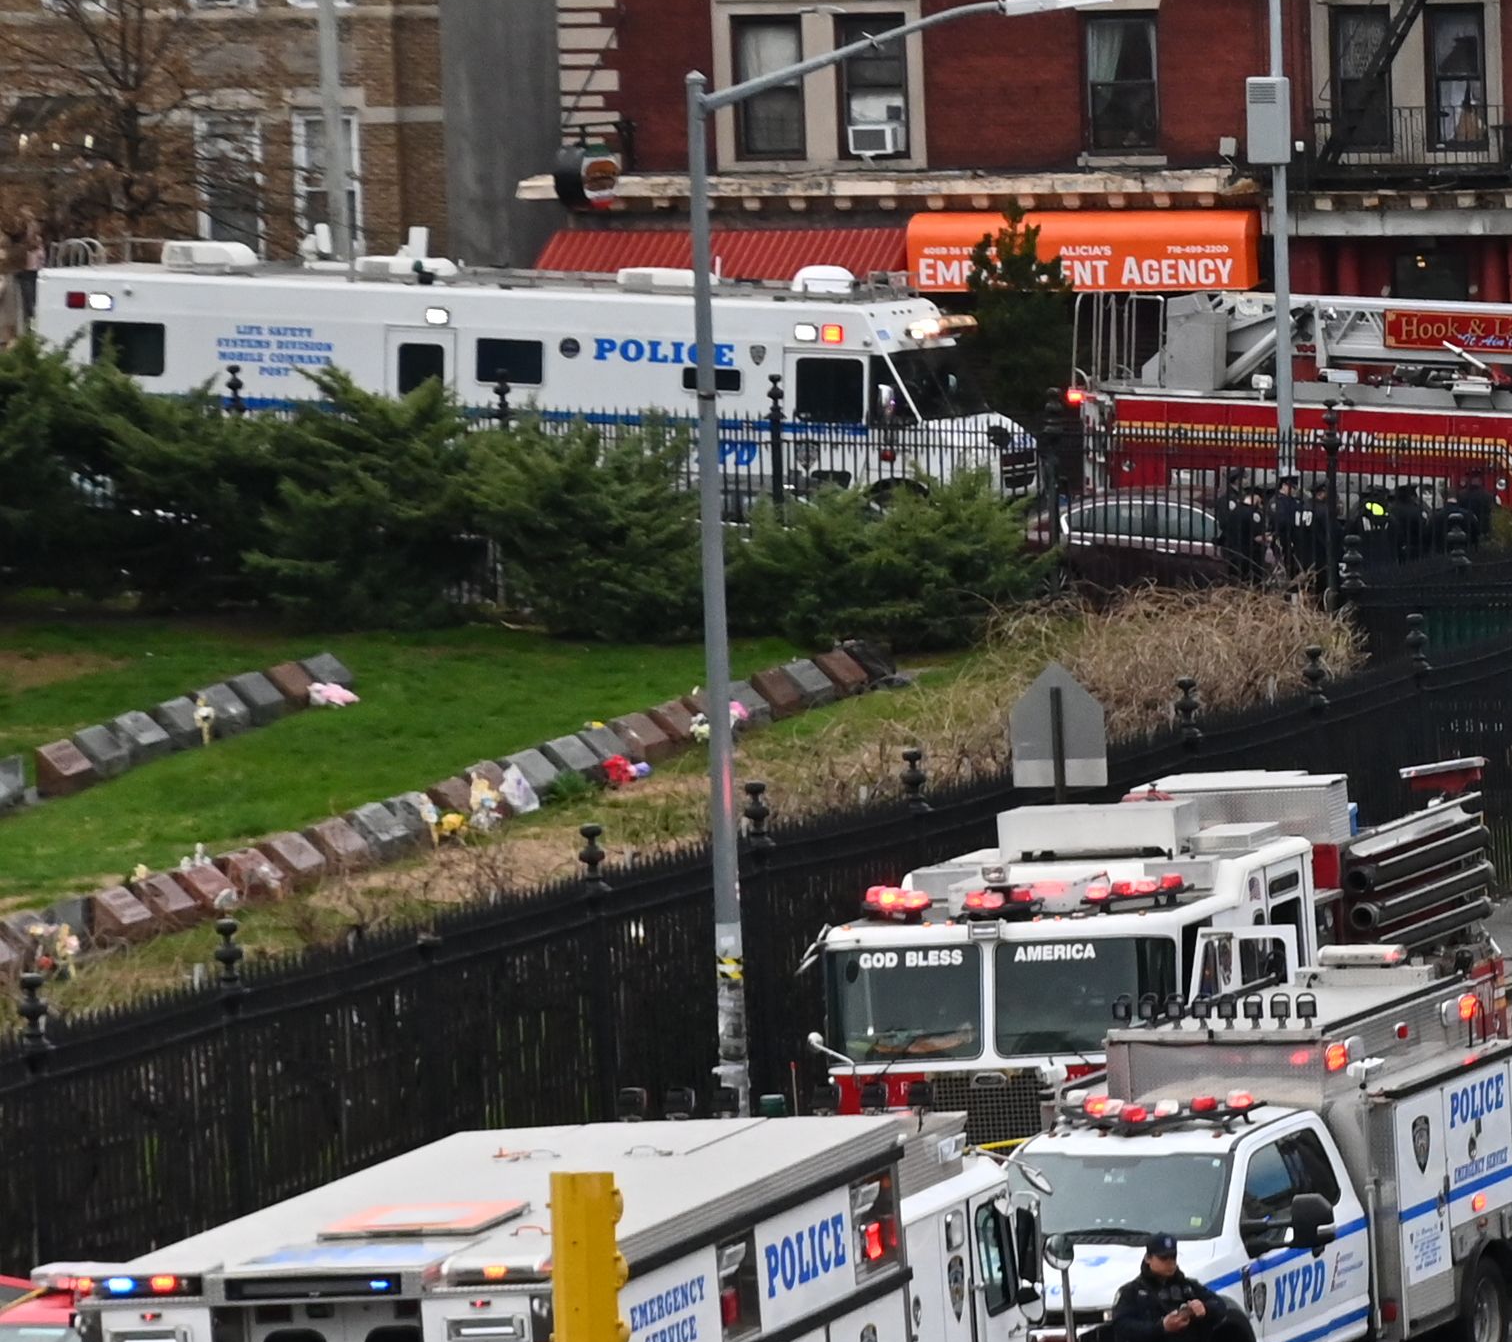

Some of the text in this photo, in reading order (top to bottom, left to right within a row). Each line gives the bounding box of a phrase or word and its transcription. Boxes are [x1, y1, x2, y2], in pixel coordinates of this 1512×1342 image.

[1060, 245, 1112, 257] ALICIA'S
[1120, 257, 1237, 286] AGENCY
[267, 326, 313, 339] SAFETY
[1400, 317, 1459, 341] Hook
[1467, 319, 1489, 340] &
[217, 337, 333, 352] SYSTEMS DIVISION
[217, 350, 332, 366] MOBILE COMMAND
[259, 365, 290, 377] POST
[858, 943, 1097, 970] GOD BLESS AMERICA
[1448, 1072, 1505, 1129] POLICE
[764, 1212, 847, 1300] POLICE
[1271, 1257, 1326, 1321] NYPD
[629, 1274, 706, 1333] EMERGENCY
